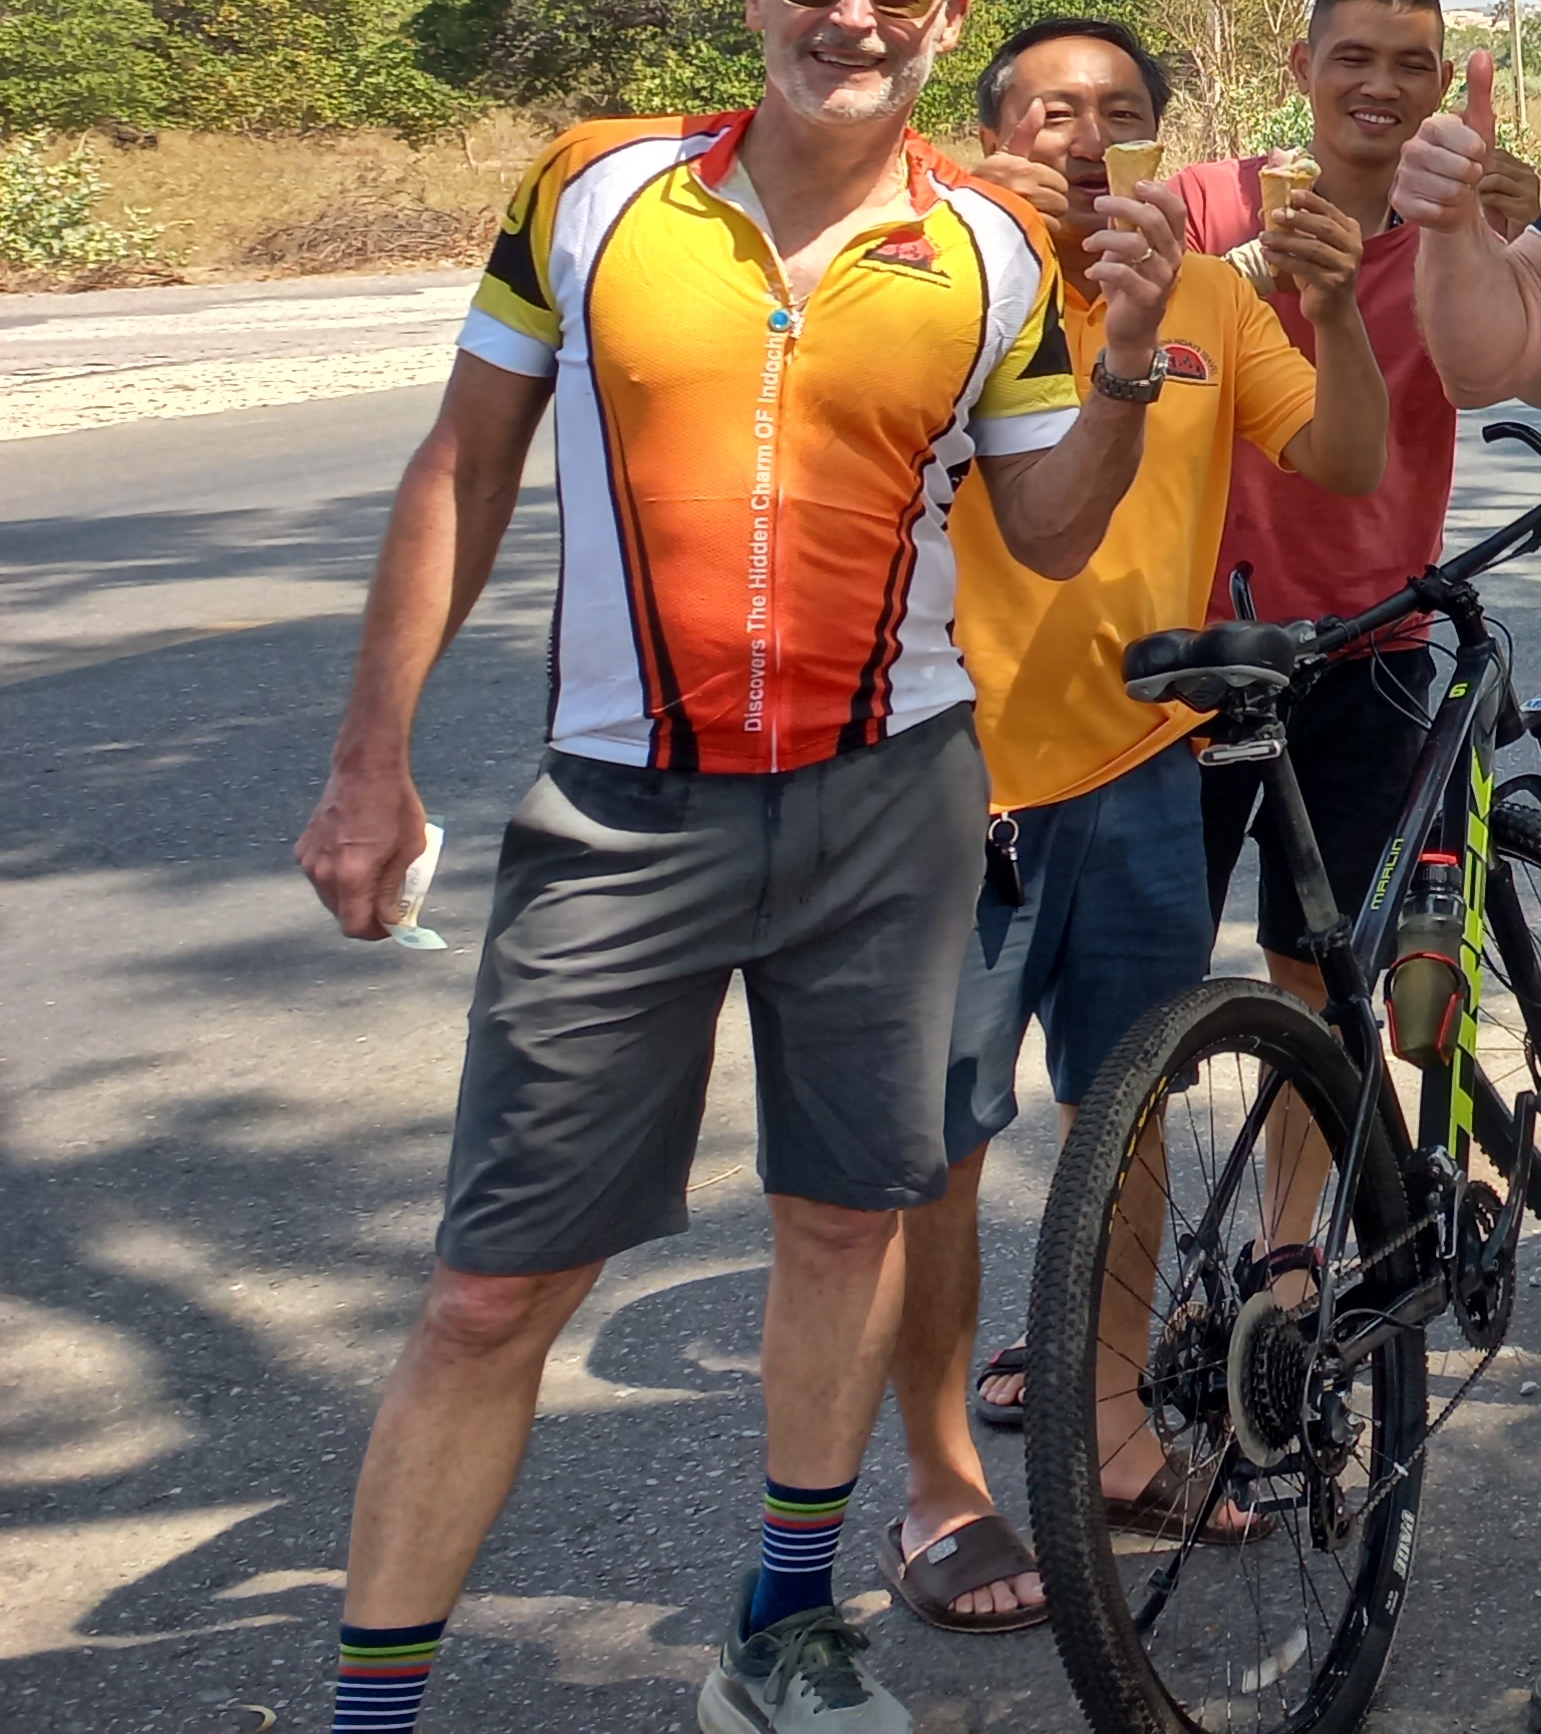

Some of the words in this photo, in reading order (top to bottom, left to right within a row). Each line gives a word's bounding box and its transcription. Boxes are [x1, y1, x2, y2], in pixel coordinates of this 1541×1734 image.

[751, 444, 774, 511] Charm
[747, 516, 769, 591] Hidden
[746, 597, 768, 633] The
[743, 637, 766, 733] Discovers
[1448, 682, 1469, 699] 6
